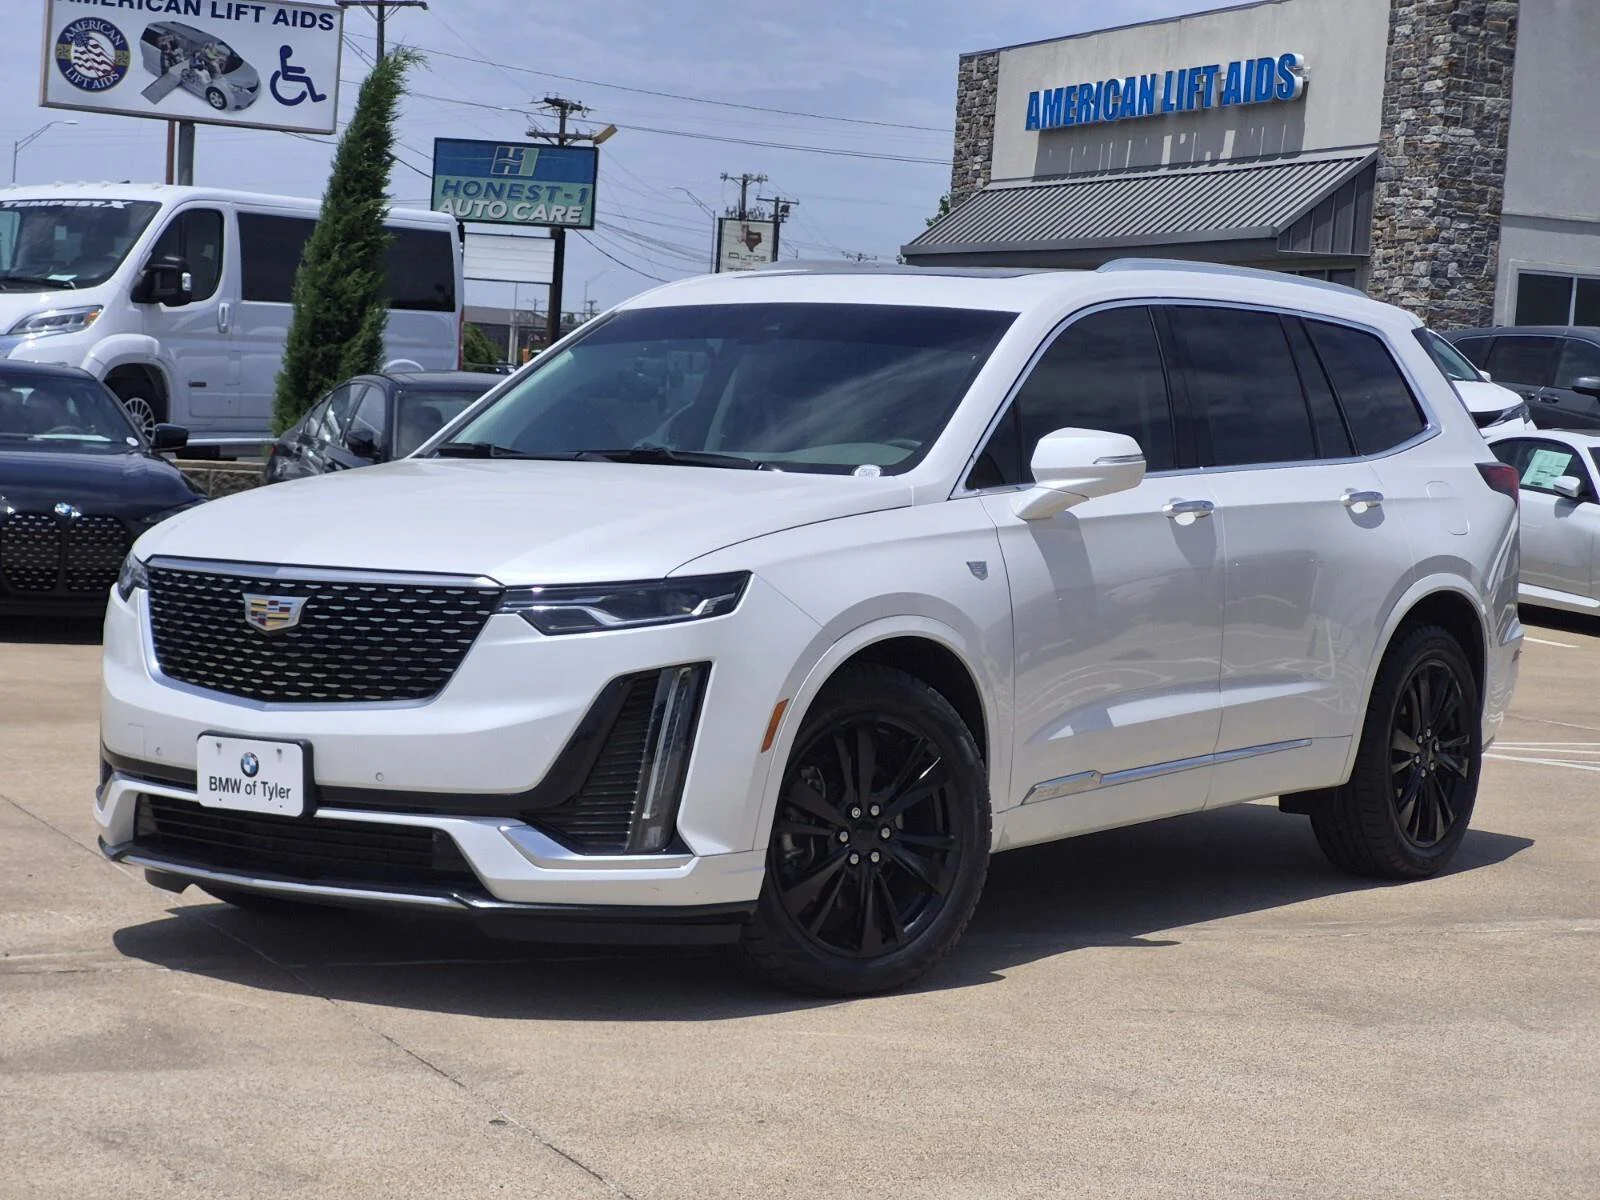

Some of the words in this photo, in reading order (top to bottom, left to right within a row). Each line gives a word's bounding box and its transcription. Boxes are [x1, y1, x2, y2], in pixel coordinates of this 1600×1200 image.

[56, 0, 201, 16] RICAN
[210, 1, 266, 23] LIFT
[272, 8, 335, 31] AIDS
[64, 20, 124, 46] AMERICAN
[65, 67, 91, 88] LIFT
[92, 71, 120, 89] AIDS
[1025, 73, 1157, 131] AMERICAN
[1162, 64, 1220, 113] LIFT
[1222, 53, 1303, 106] AIDS
[441, 179, 590, 205] HONEST-1
[437, 198, 508, 219] AUTO
[512, 202, 583, 224] CARE
[209, 776, 241, 794] BMW
[245, 781, 257, 796] of
[261, 781, 291, 801] Tyler
